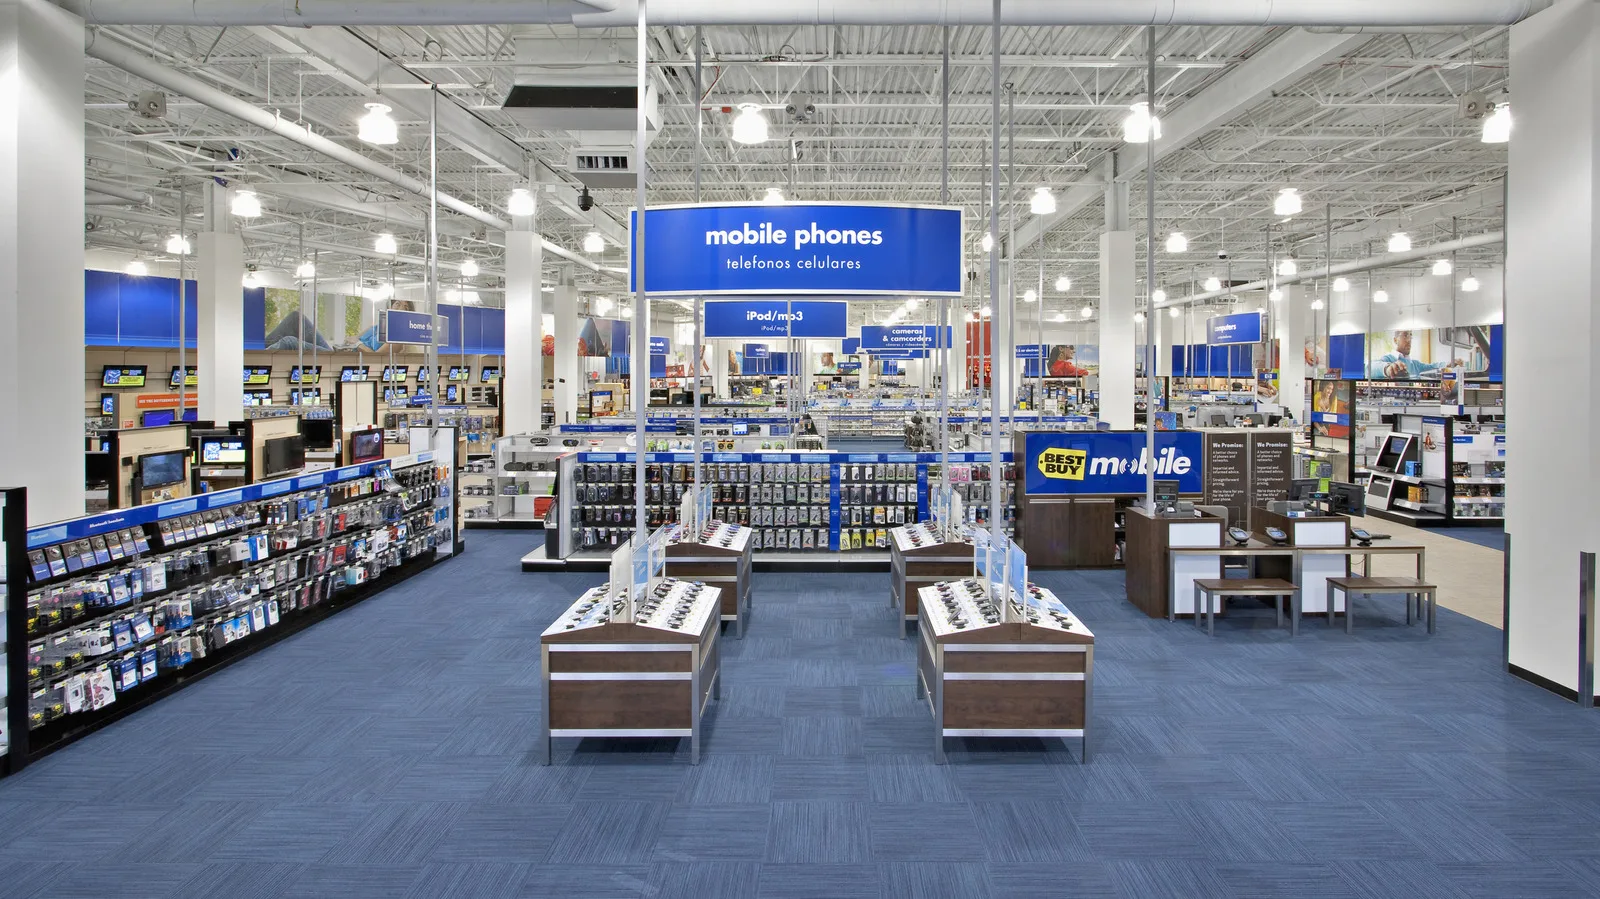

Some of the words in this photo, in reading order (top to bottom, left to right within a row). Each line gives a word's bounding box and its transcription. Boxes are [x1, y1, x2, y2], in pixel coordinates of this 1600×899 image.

[705, 222, 787, 245] mobile
[795, 222, 883, 250] phones
[727, 254, 791, 269] telefonos
[796, 254, 861, 269] celulares
[409, 320, 425, 330] home
[1044, 452, 1084, 466] BEST
[1089, 447, 1191, 475] mobile
[1045, 464, 1082, 475] BUY
